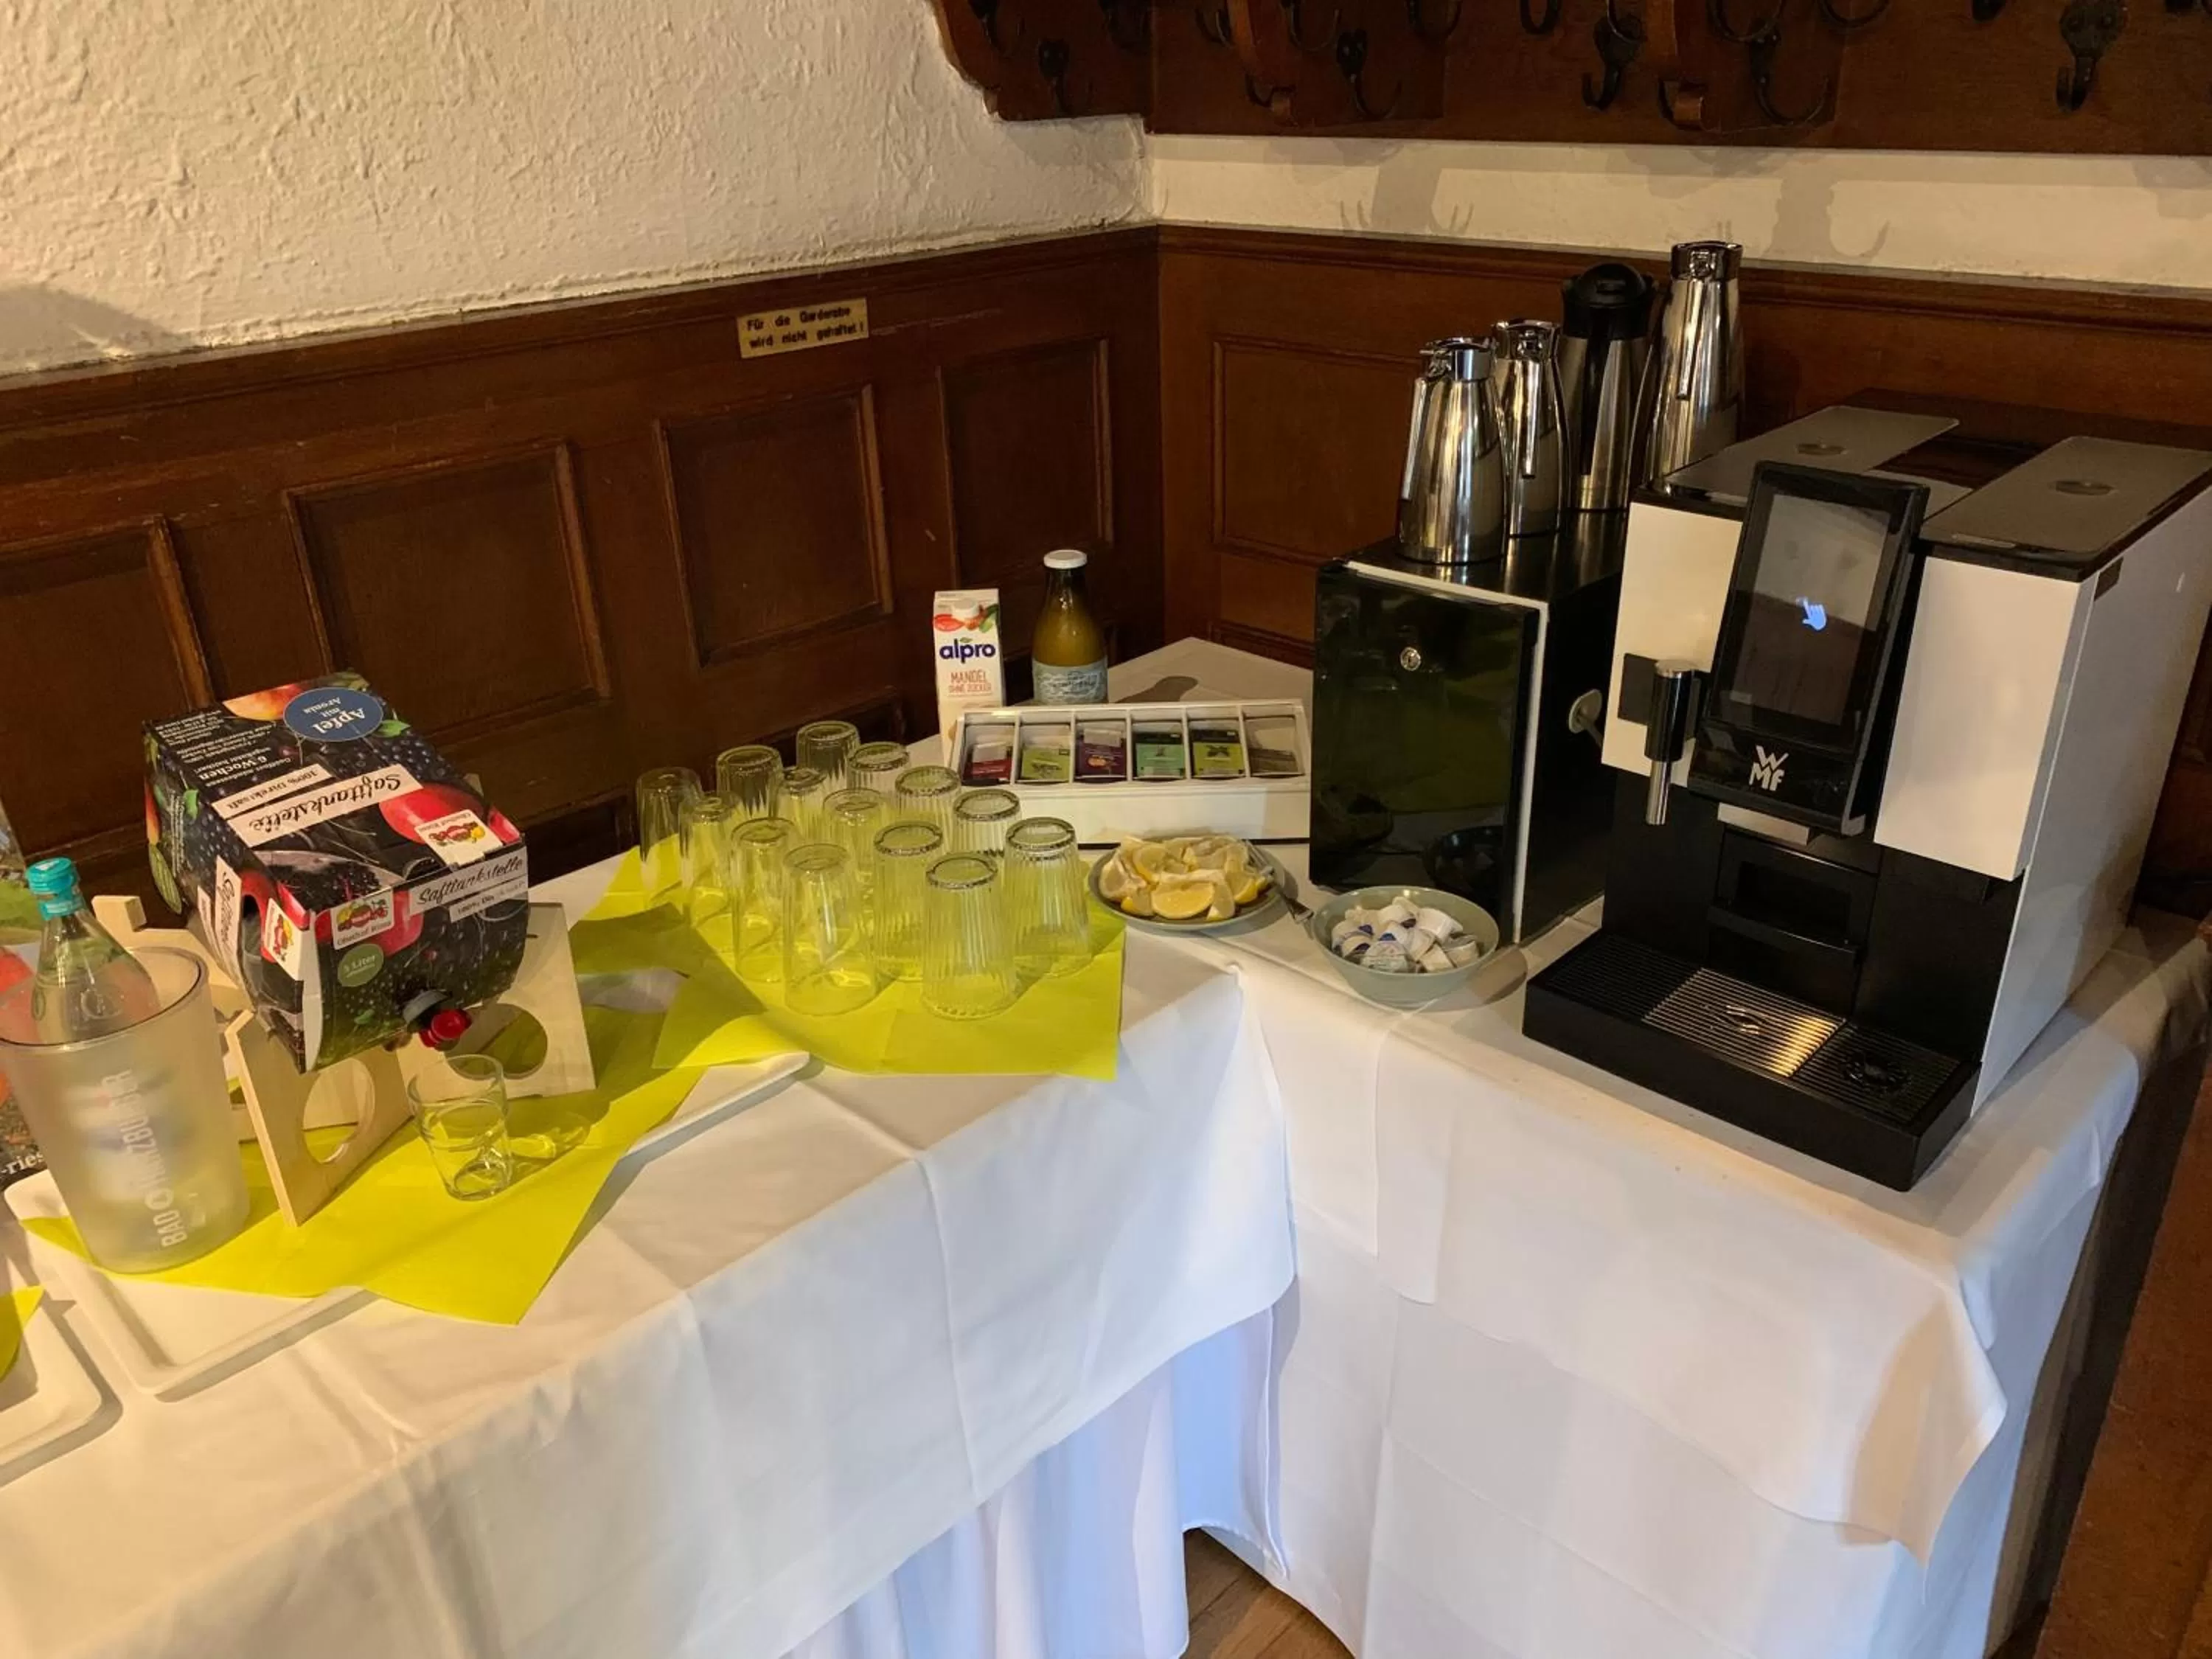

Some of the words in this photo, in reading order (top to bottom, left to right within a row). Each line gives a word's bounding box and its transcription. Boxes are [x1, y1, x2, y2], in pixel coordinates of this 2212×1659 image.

[747, 319, 764, 330] Für
[749, 335, 773, 349] wird
[782, 330, 807, 343] nicht
[939, 639, 995, 664] alpro
[950, 670, 986, 683] MANDEL
[302, 697, 341, 714] Aronia
[321, 707, 341, 717] mit
[312, 708, 365, 734] Apfel
[198, 760, 257, 781] Wochen
[288, 769, 320, 785] 100%
[226, 782, 288, 810] Direktsaft
[248, 773, 401, 832] Safttankstelle
[153, 1209, 187, 1248] BAD
